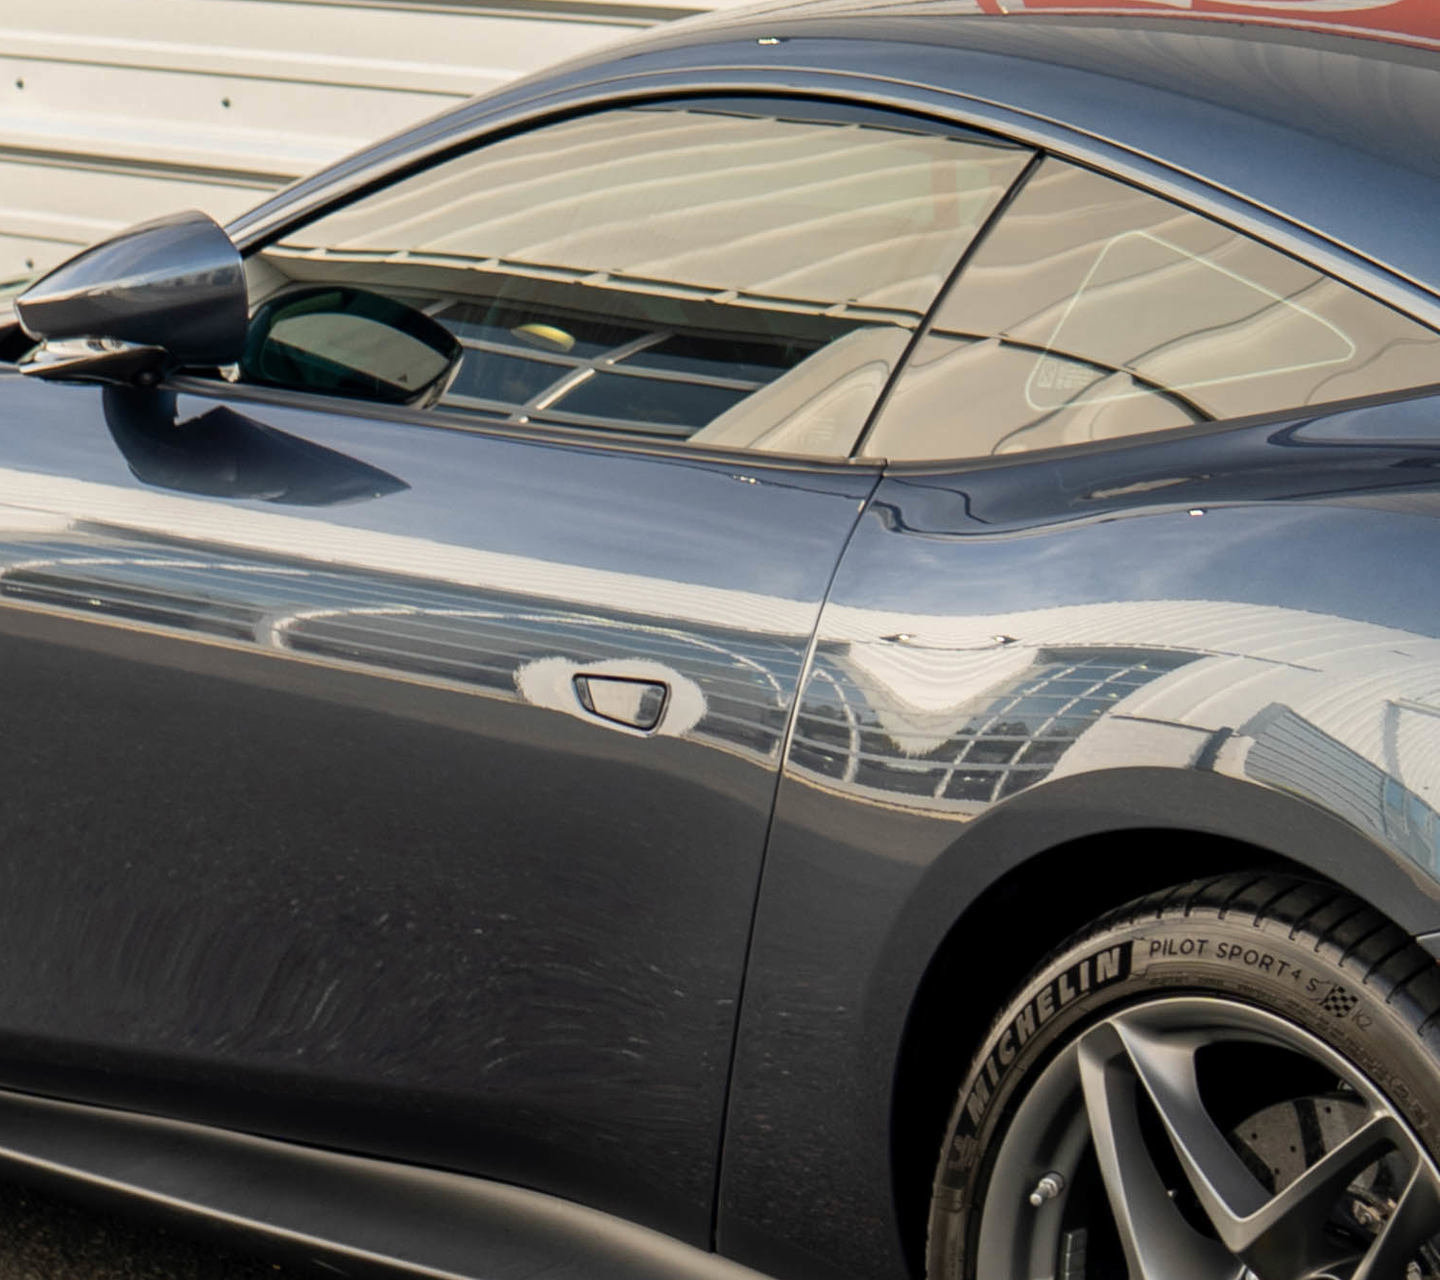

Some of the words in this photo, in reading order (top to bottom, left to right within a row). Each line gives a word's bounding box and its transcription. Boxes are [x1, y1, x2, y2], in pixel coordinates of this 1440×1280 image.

[1149, 937, 1209, 958] PILOT
[1305, 977, 1320, 993] S
[966, 946, 1121, 1129] MICHELIN
